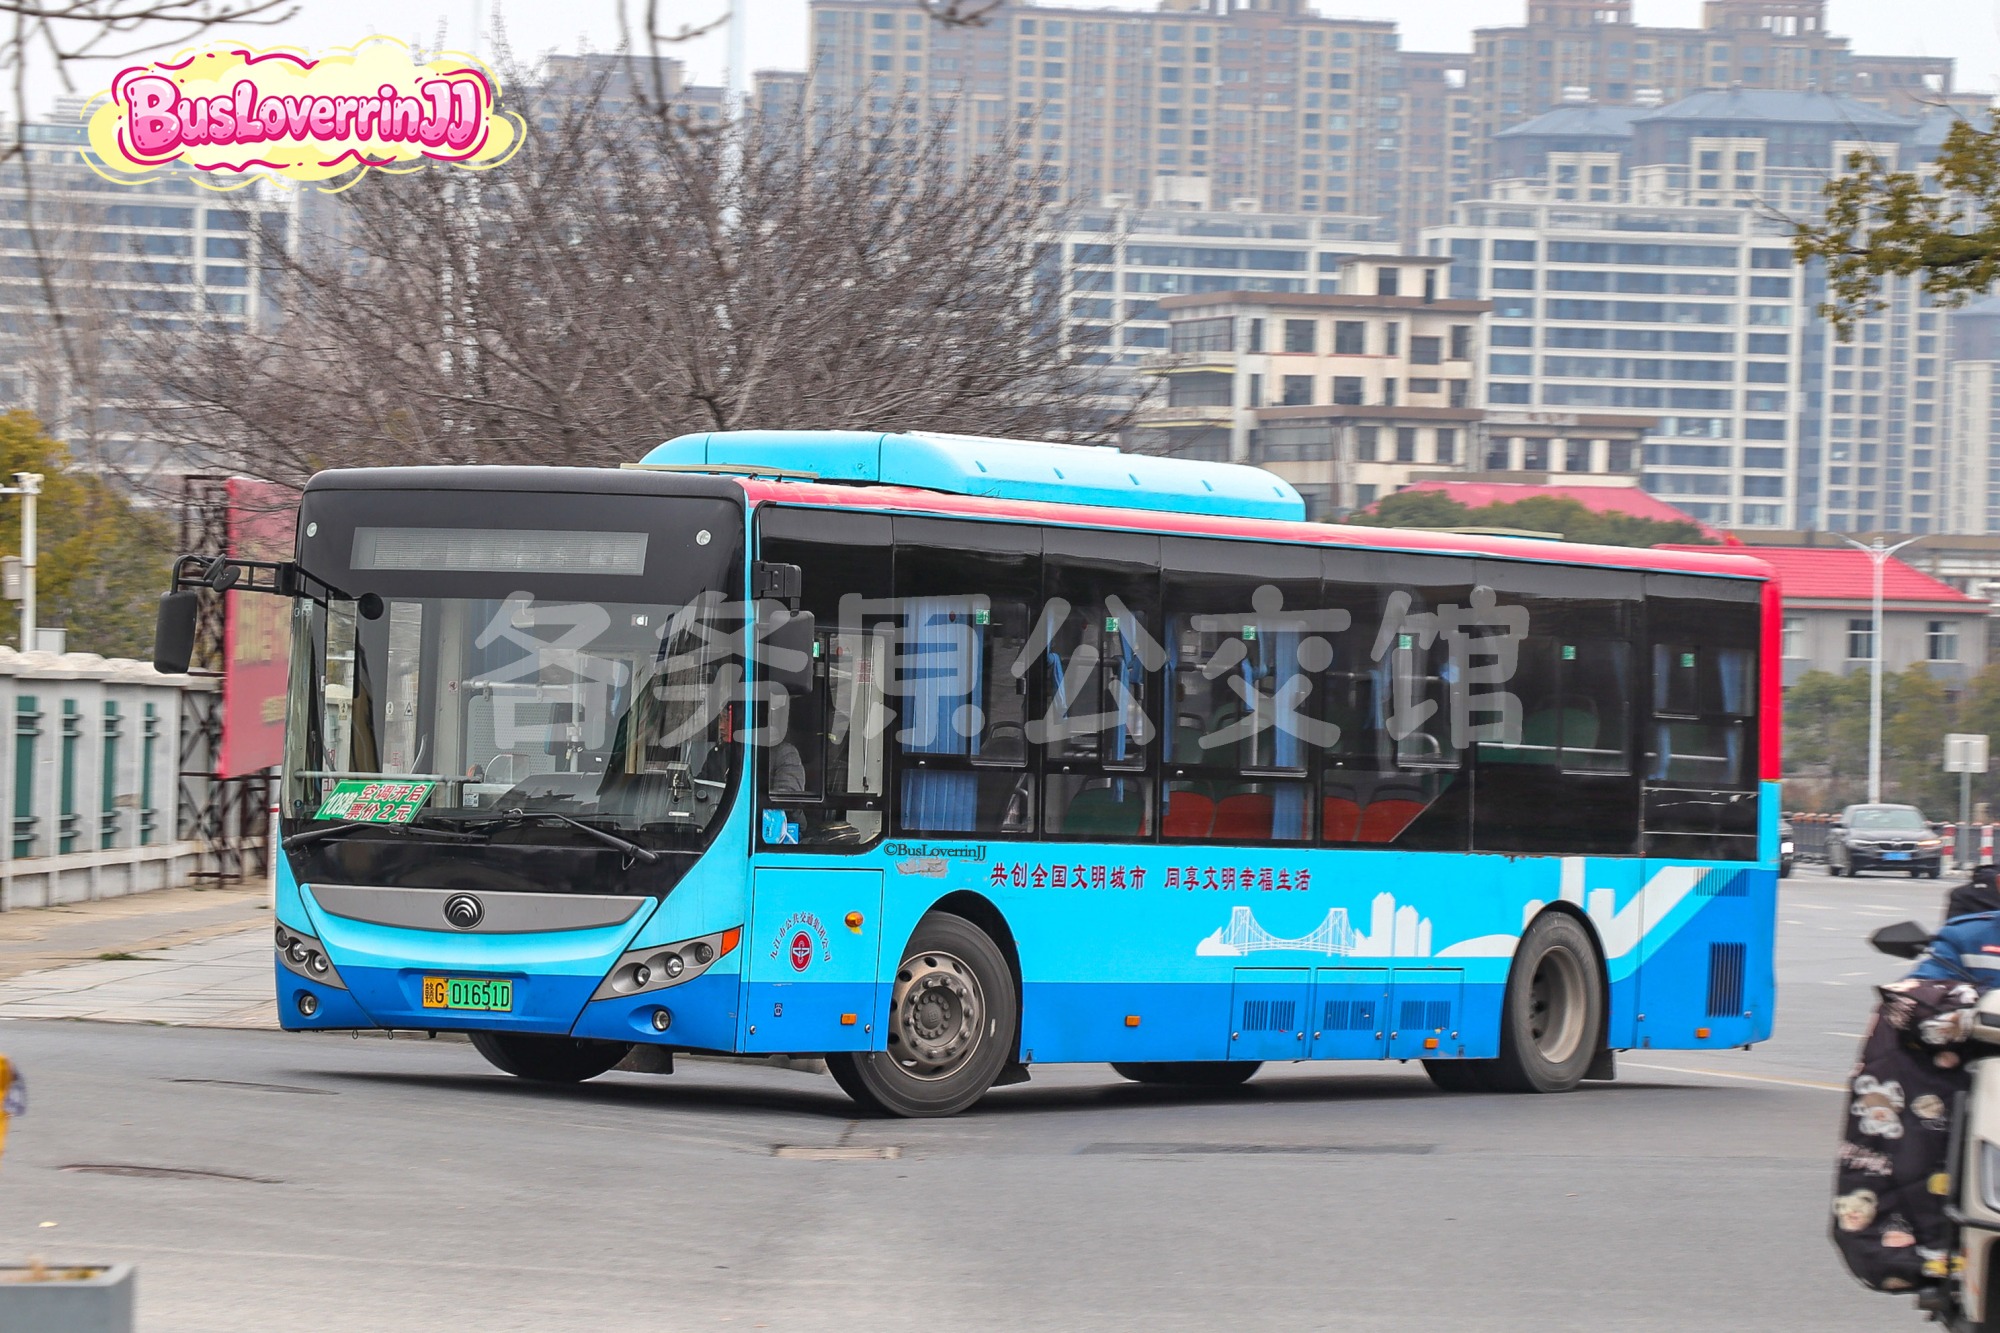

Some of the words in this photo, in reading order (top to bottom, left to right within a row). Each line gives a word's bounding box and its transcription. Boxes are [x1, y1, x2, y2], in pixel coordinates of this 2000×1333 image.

[359, 785, 426, 802] 空调开启
[990, 862, 1147, 891] 共创全国文明城市
[1164, 866, 1312, 892] 同享文明幸福生活
